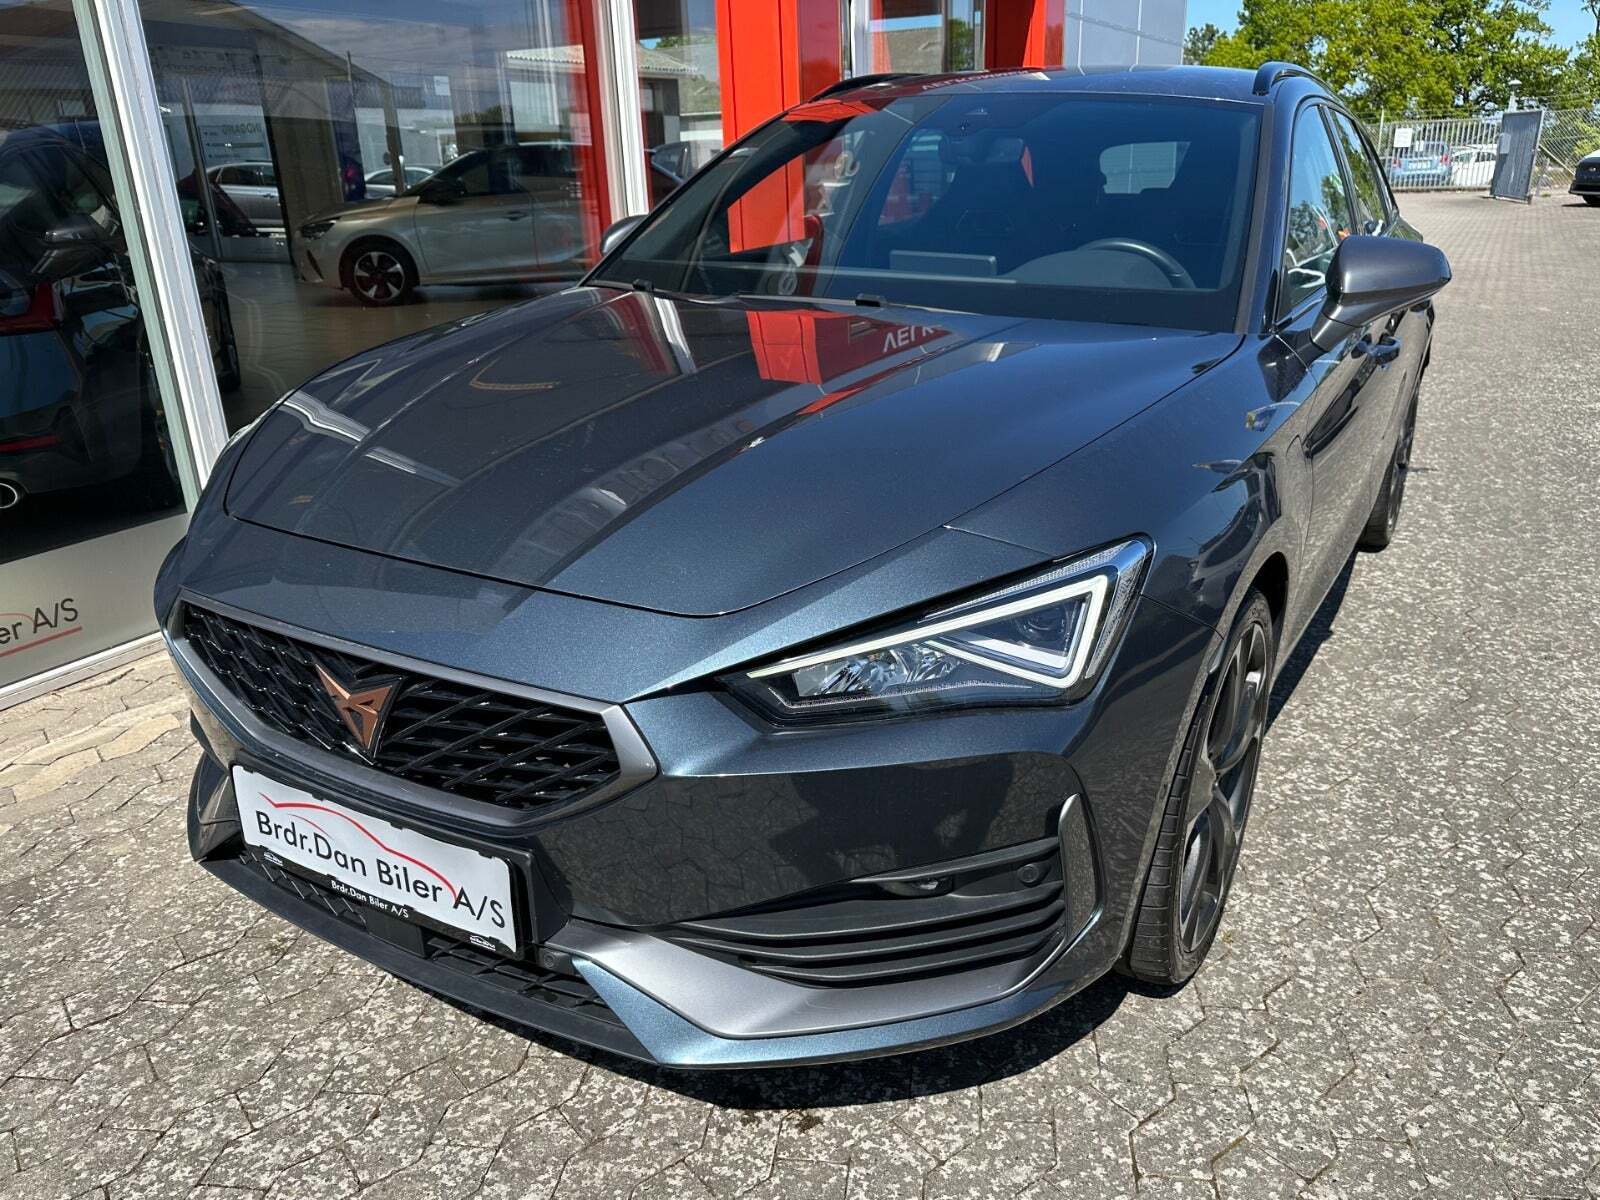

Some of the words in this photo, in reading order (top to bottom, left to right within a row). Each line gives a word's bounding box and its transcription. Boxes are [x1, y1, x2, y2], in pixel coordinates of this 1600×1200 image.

[32, 597, 79, 634] A/S
[255, 810, 367, 877] Brdr.Dan
[376, 858, 443, 903] Biler
[452, 886, 506, 929] A/S
[331, 880, 367, 902] Brdr.Dan
[368, 895, 389, 910] Biler
[391, 904, 409, 919] A/S
